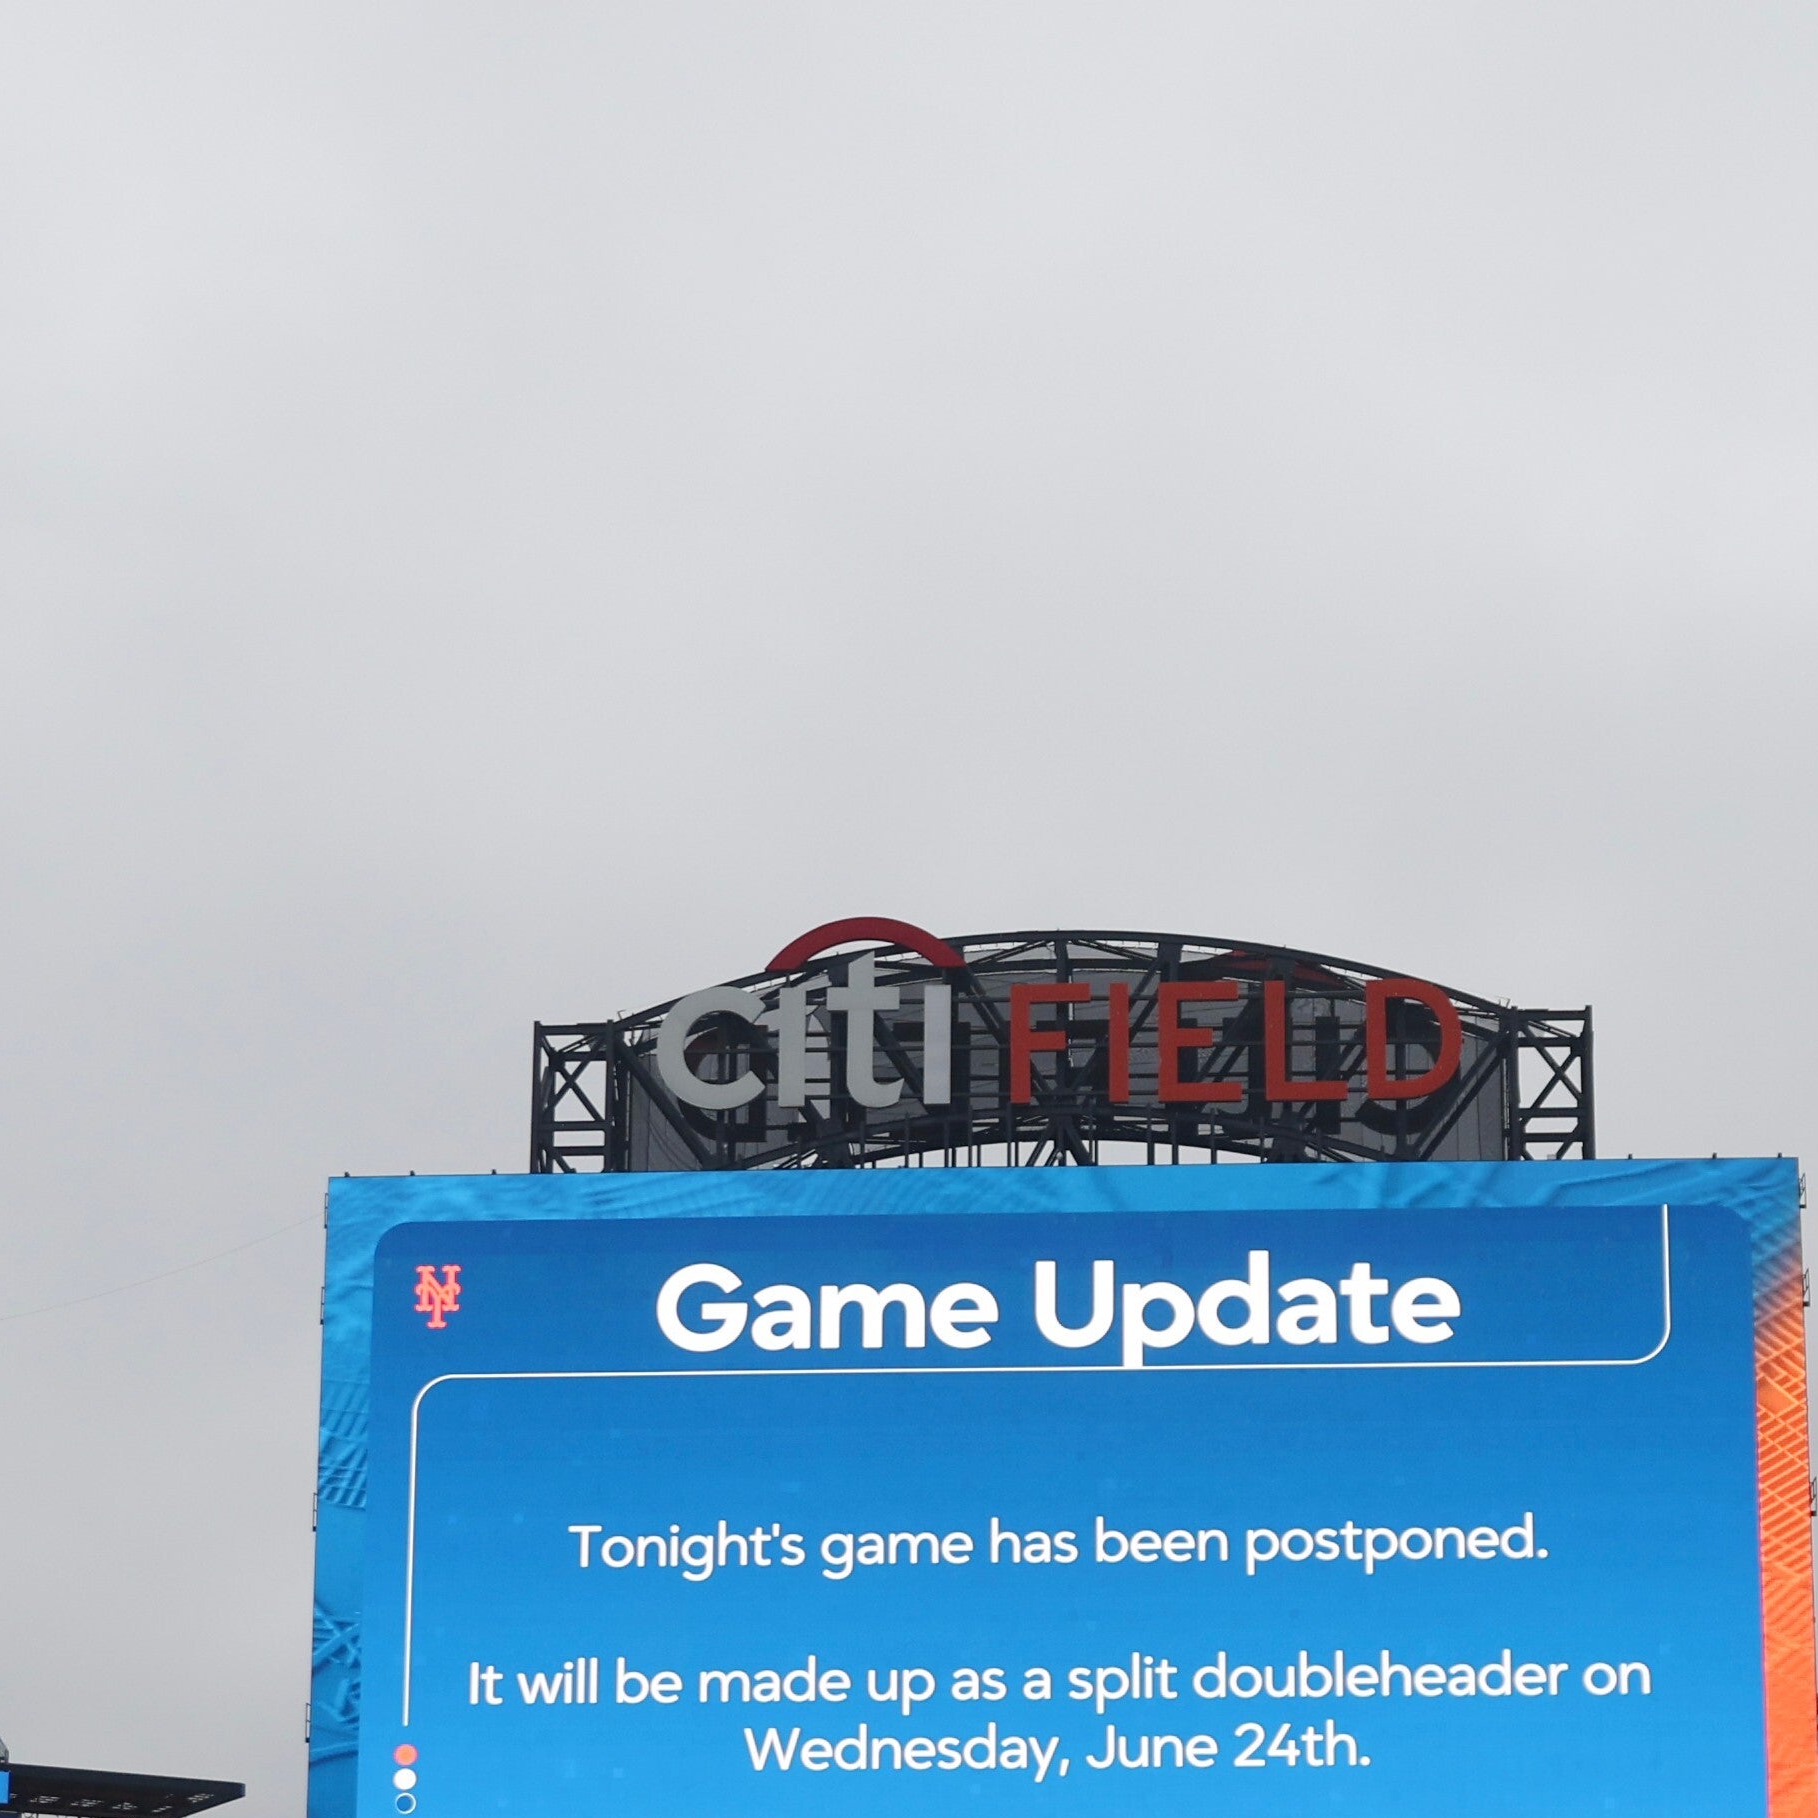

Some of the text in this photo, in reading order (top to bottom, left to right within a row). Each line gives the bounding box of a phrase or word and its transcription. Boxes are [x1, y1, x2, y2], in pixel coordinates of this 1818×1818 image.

[658, 951, 1462, 1110] citi FIELD
[656, 1251, 1460, 1368] Game Update
[568, 1510, 1549, 1578] Tonight's game has been postponed.
[468, 1650, 1652, 1712] It will be made up as a split doubleheader on
[743, 1720, 1371, 1780] Wednesday, June 24th.
